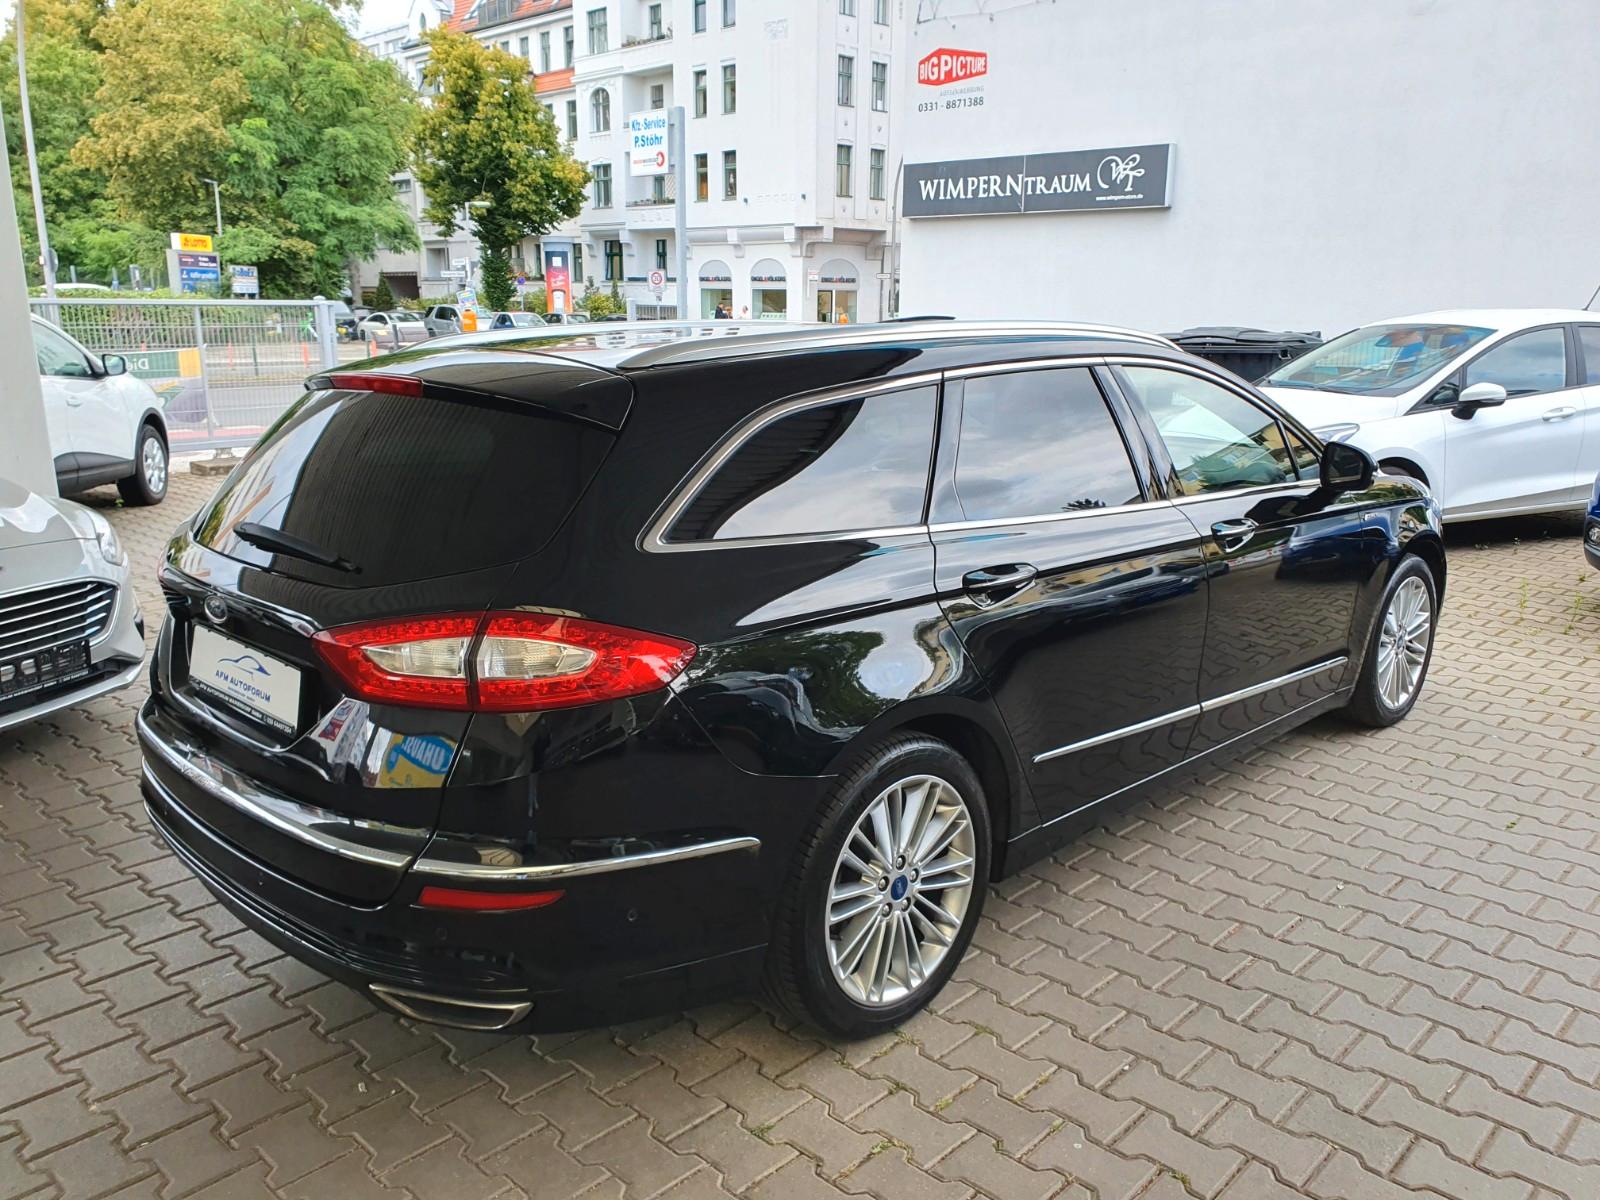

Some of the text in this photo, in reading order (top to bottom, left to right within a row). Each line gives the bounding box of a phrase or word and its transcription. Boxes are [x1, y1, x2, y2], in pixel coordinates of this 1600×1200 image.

[918, 102, 938, 112] 0331
[946, 96, 984, 109] 8871388
[215, 669, 229, 682] AFM
[229, 679, 271, 702] AUTOFORUM
